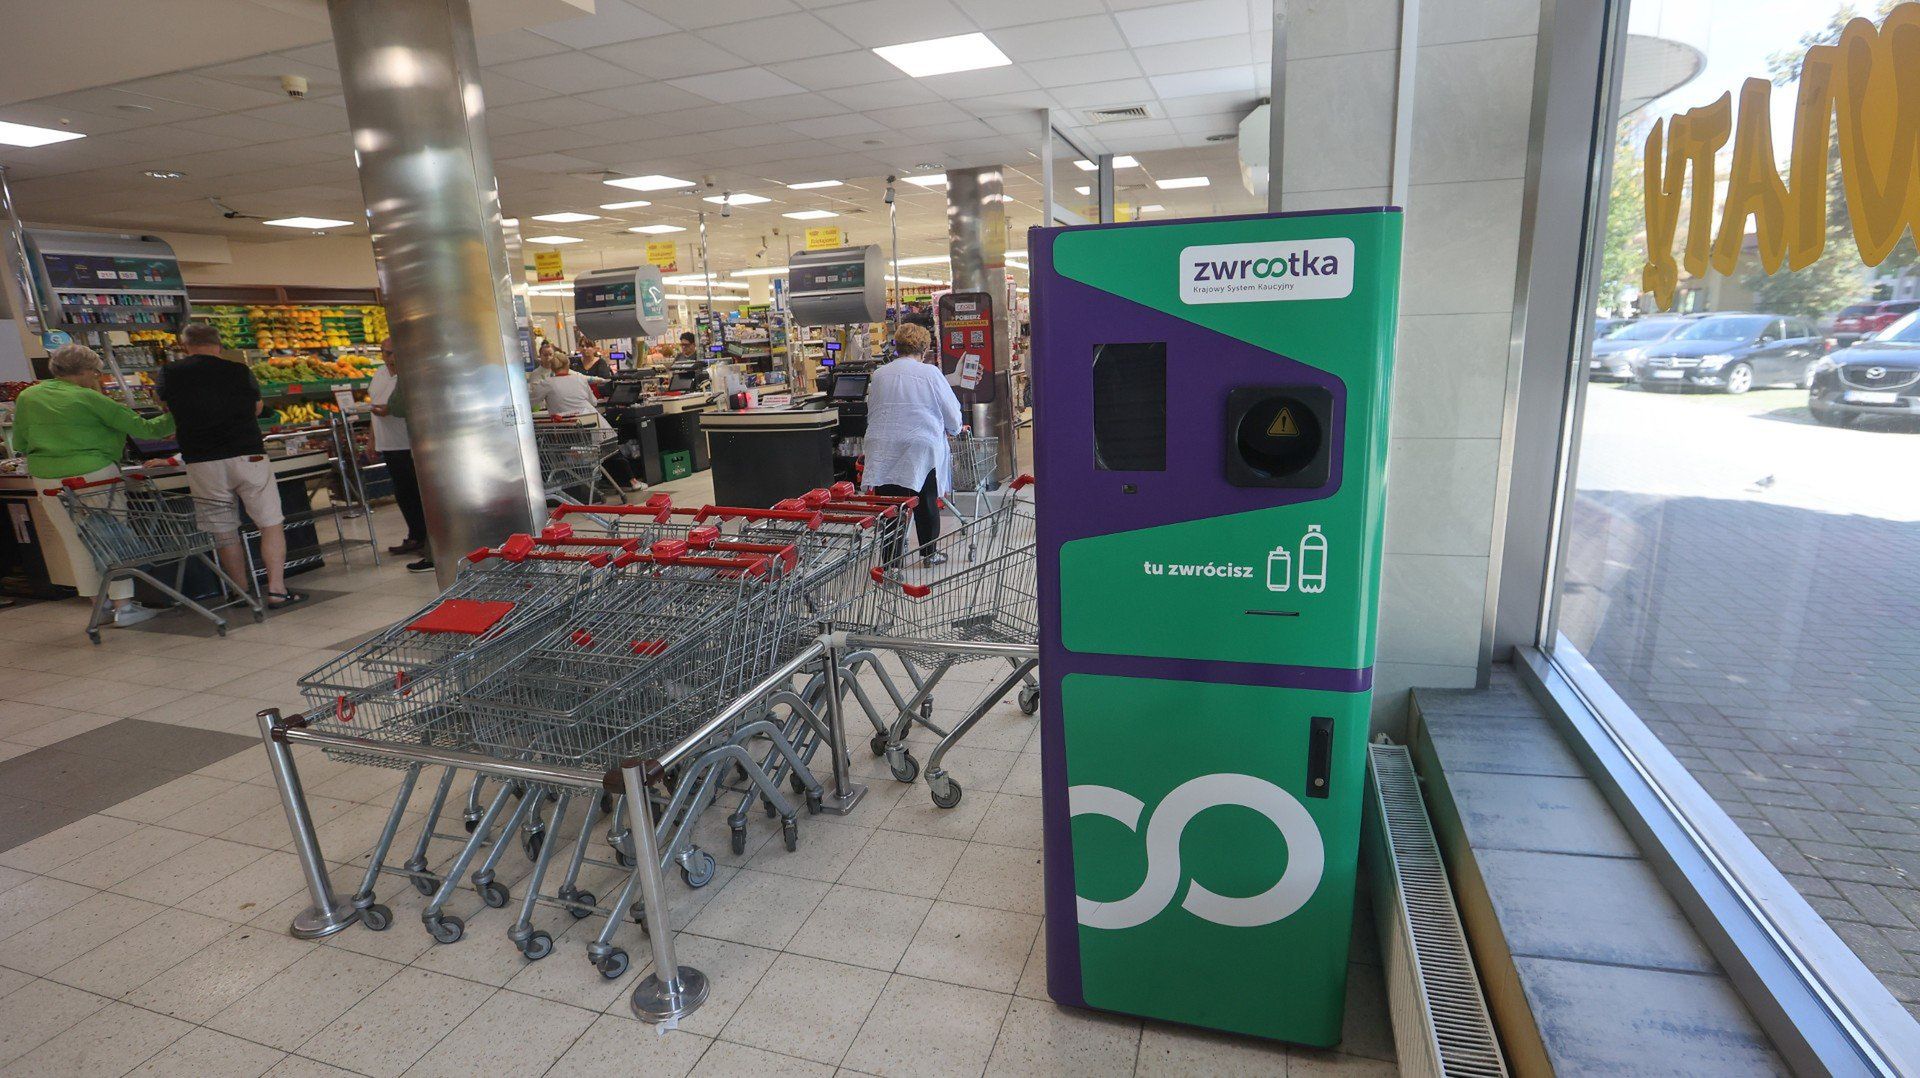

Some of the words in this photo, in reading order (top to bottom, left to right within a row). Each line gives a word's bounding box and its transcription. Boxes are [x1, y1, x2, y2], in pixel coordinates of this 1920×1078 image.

[1193, 284, 1225, 294] Krajowy
[1227, 283, 1256, 292] System
[1258, 281, 1295, 292] Kaucyjny
[1143, 561, 1164, 576] tu
[1168, 561, 1254, 578] zwrócisz
